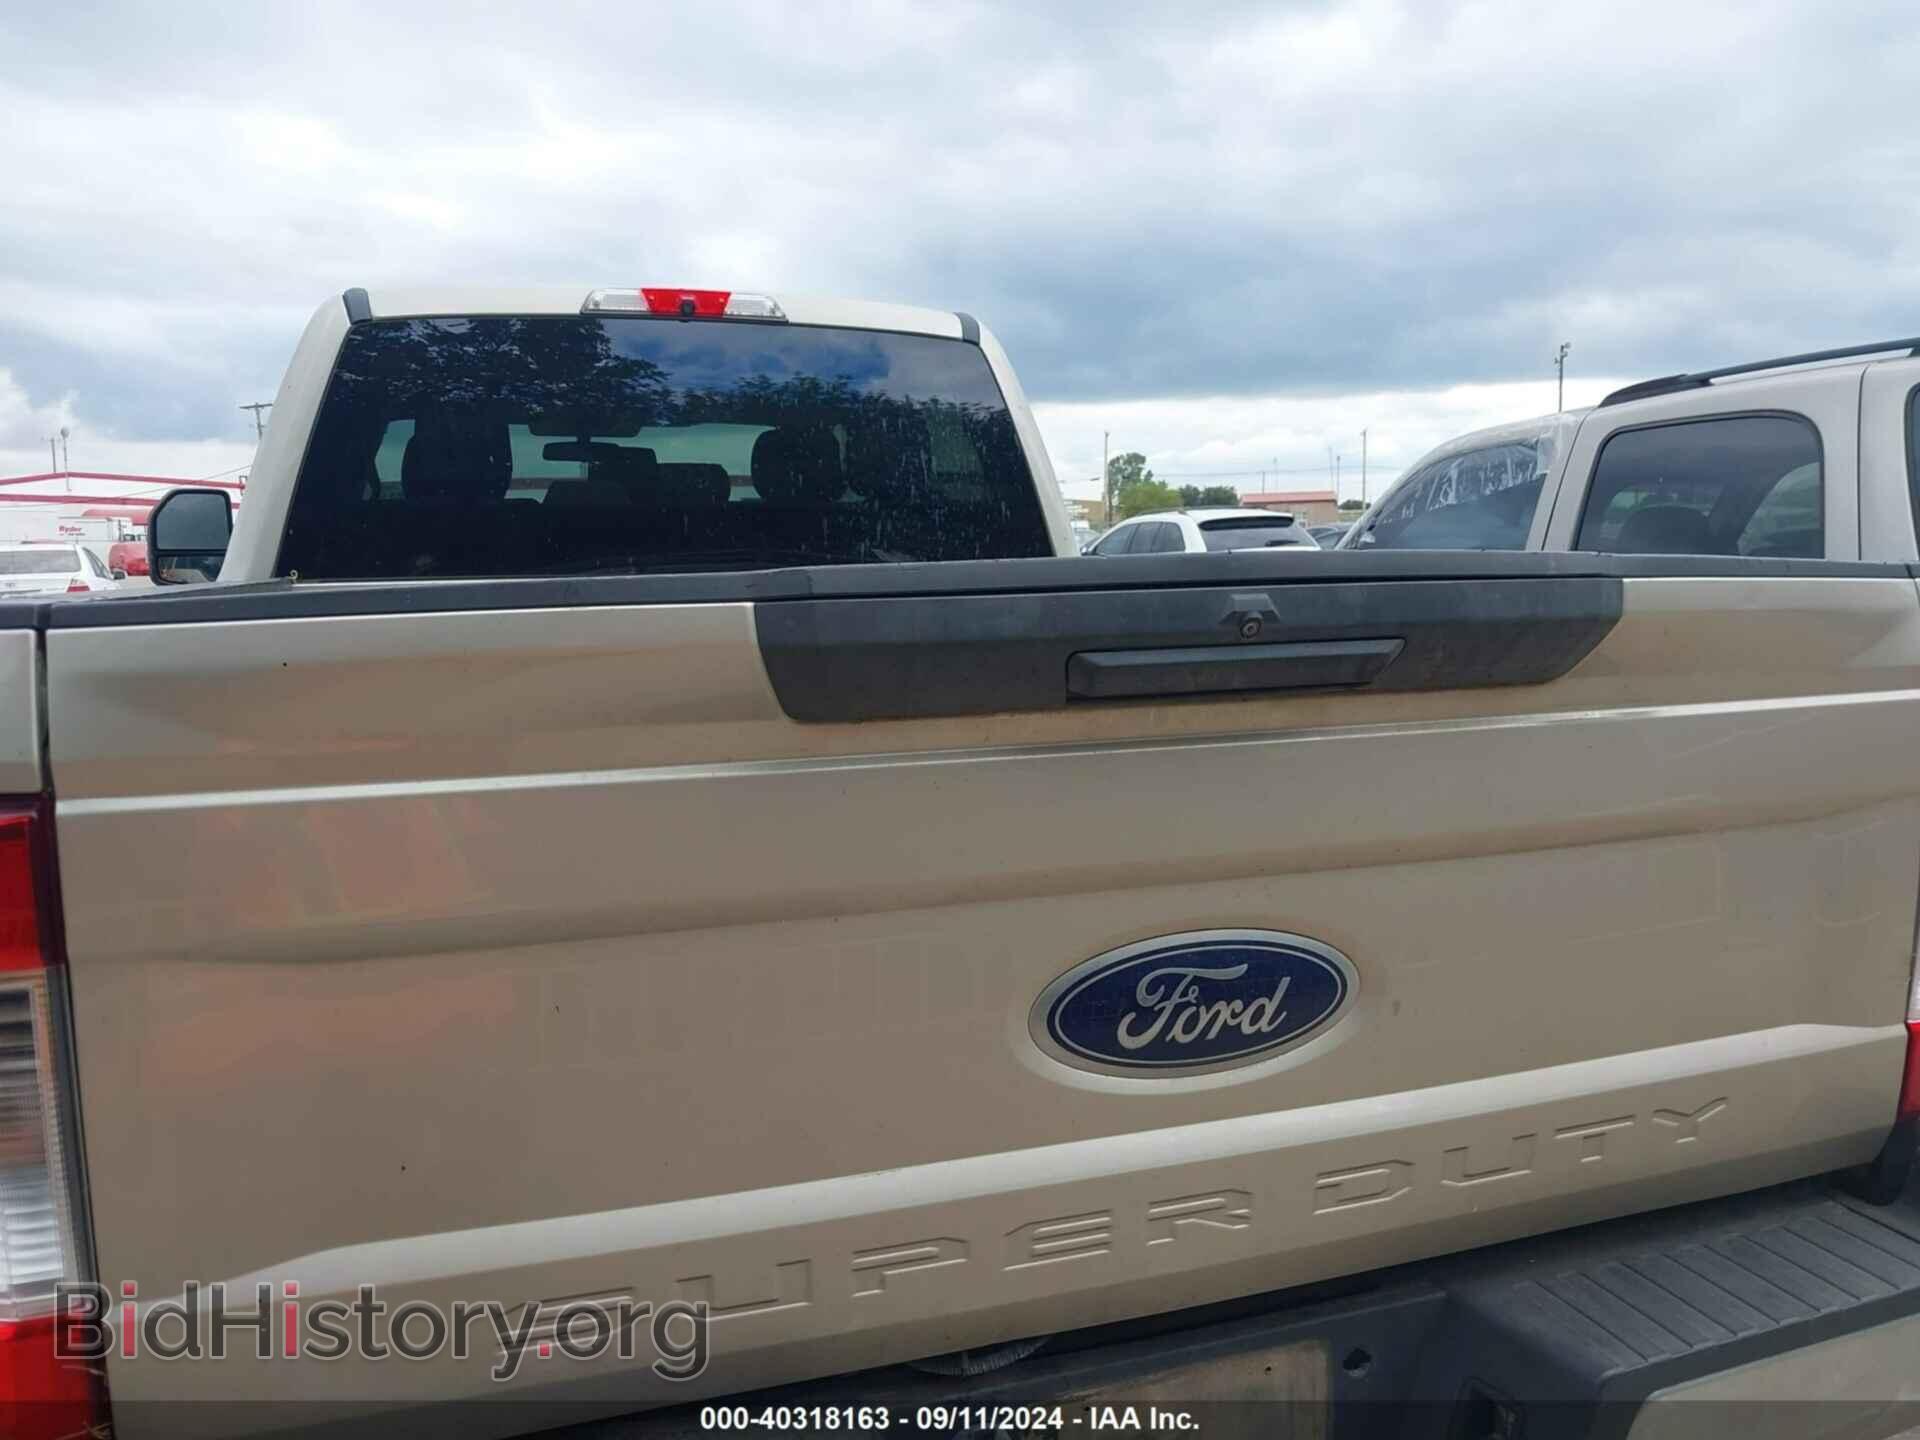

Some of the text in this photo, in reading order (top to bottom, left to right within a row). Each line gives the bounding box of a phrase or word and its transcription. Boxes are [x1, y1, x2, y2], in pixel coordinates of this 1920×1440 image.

[1117, 963, 1291, 1049] Ford
[496, 1096, 1729, 1356] SUPER DUTY
